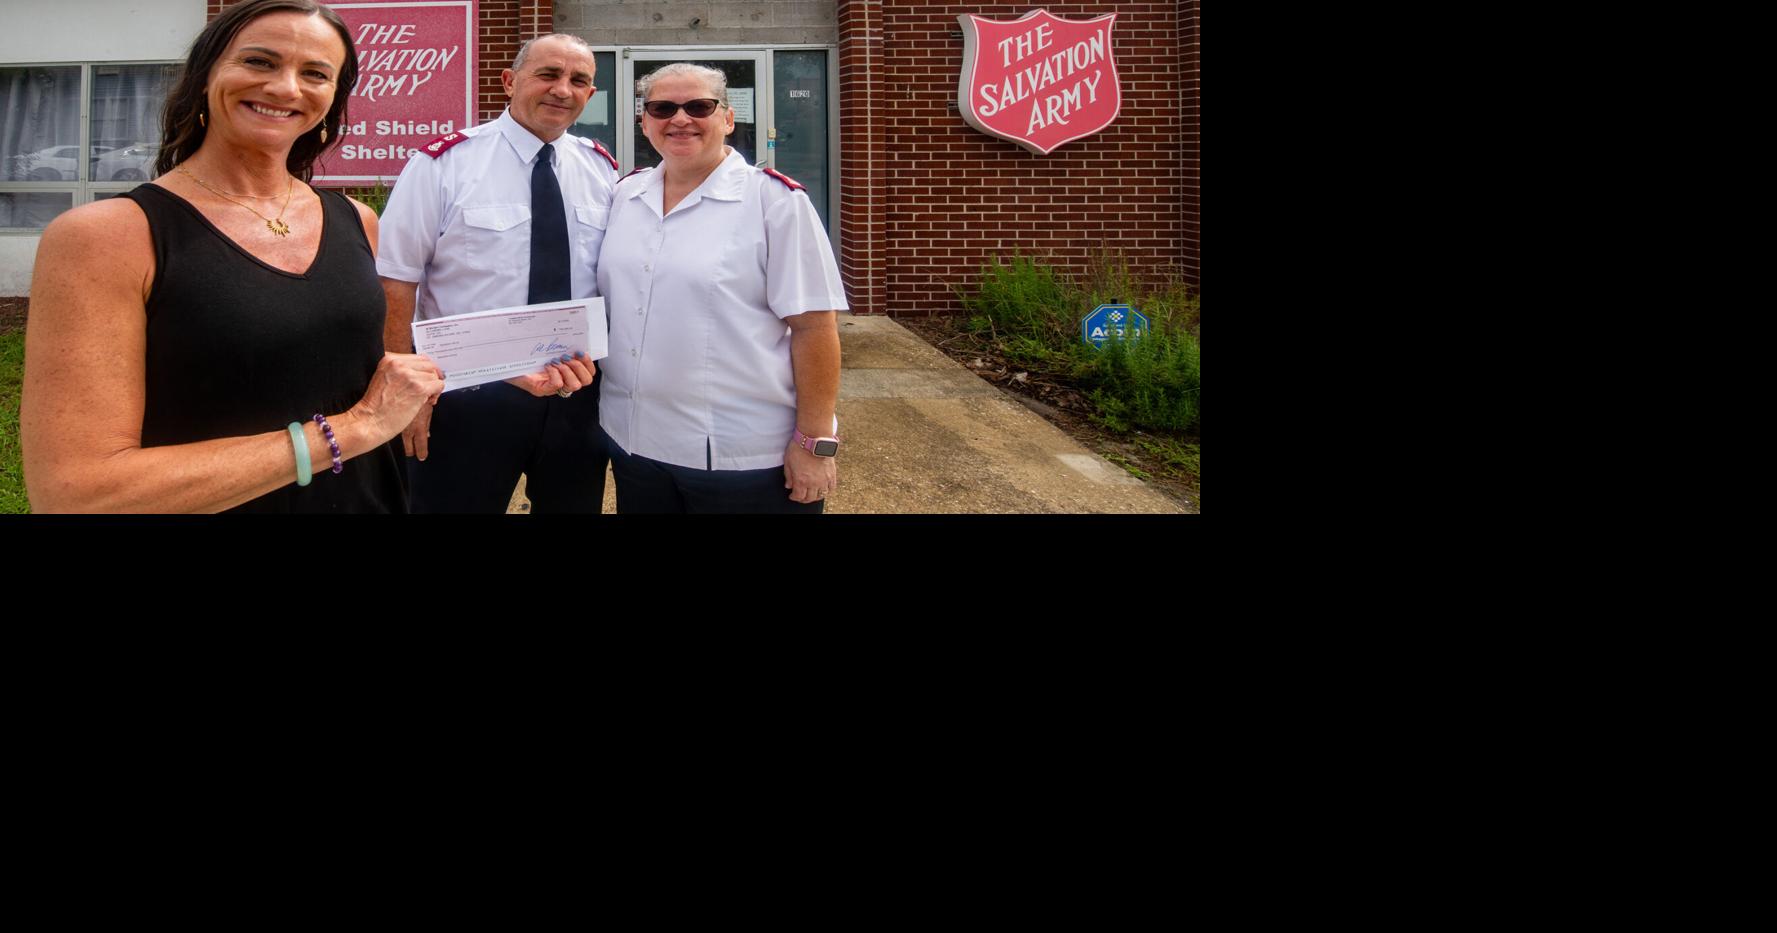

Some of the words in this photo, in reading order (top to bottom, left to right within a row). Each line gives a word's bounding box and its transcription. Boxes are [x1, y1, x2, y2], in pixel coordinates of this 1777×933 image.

[355, 23, 416, 45] THE
[998, 22, 1054, 68] THE
[357, 45, 459, 71] LVATION
[979, 29, 1105, 117] SALVATION
[1025, 69, 1102, 137] ARMY
[338, 120, 367, 136] ed
[375, 120, 454, 136] Shield
[340, 144, 418, 160] Shelte
